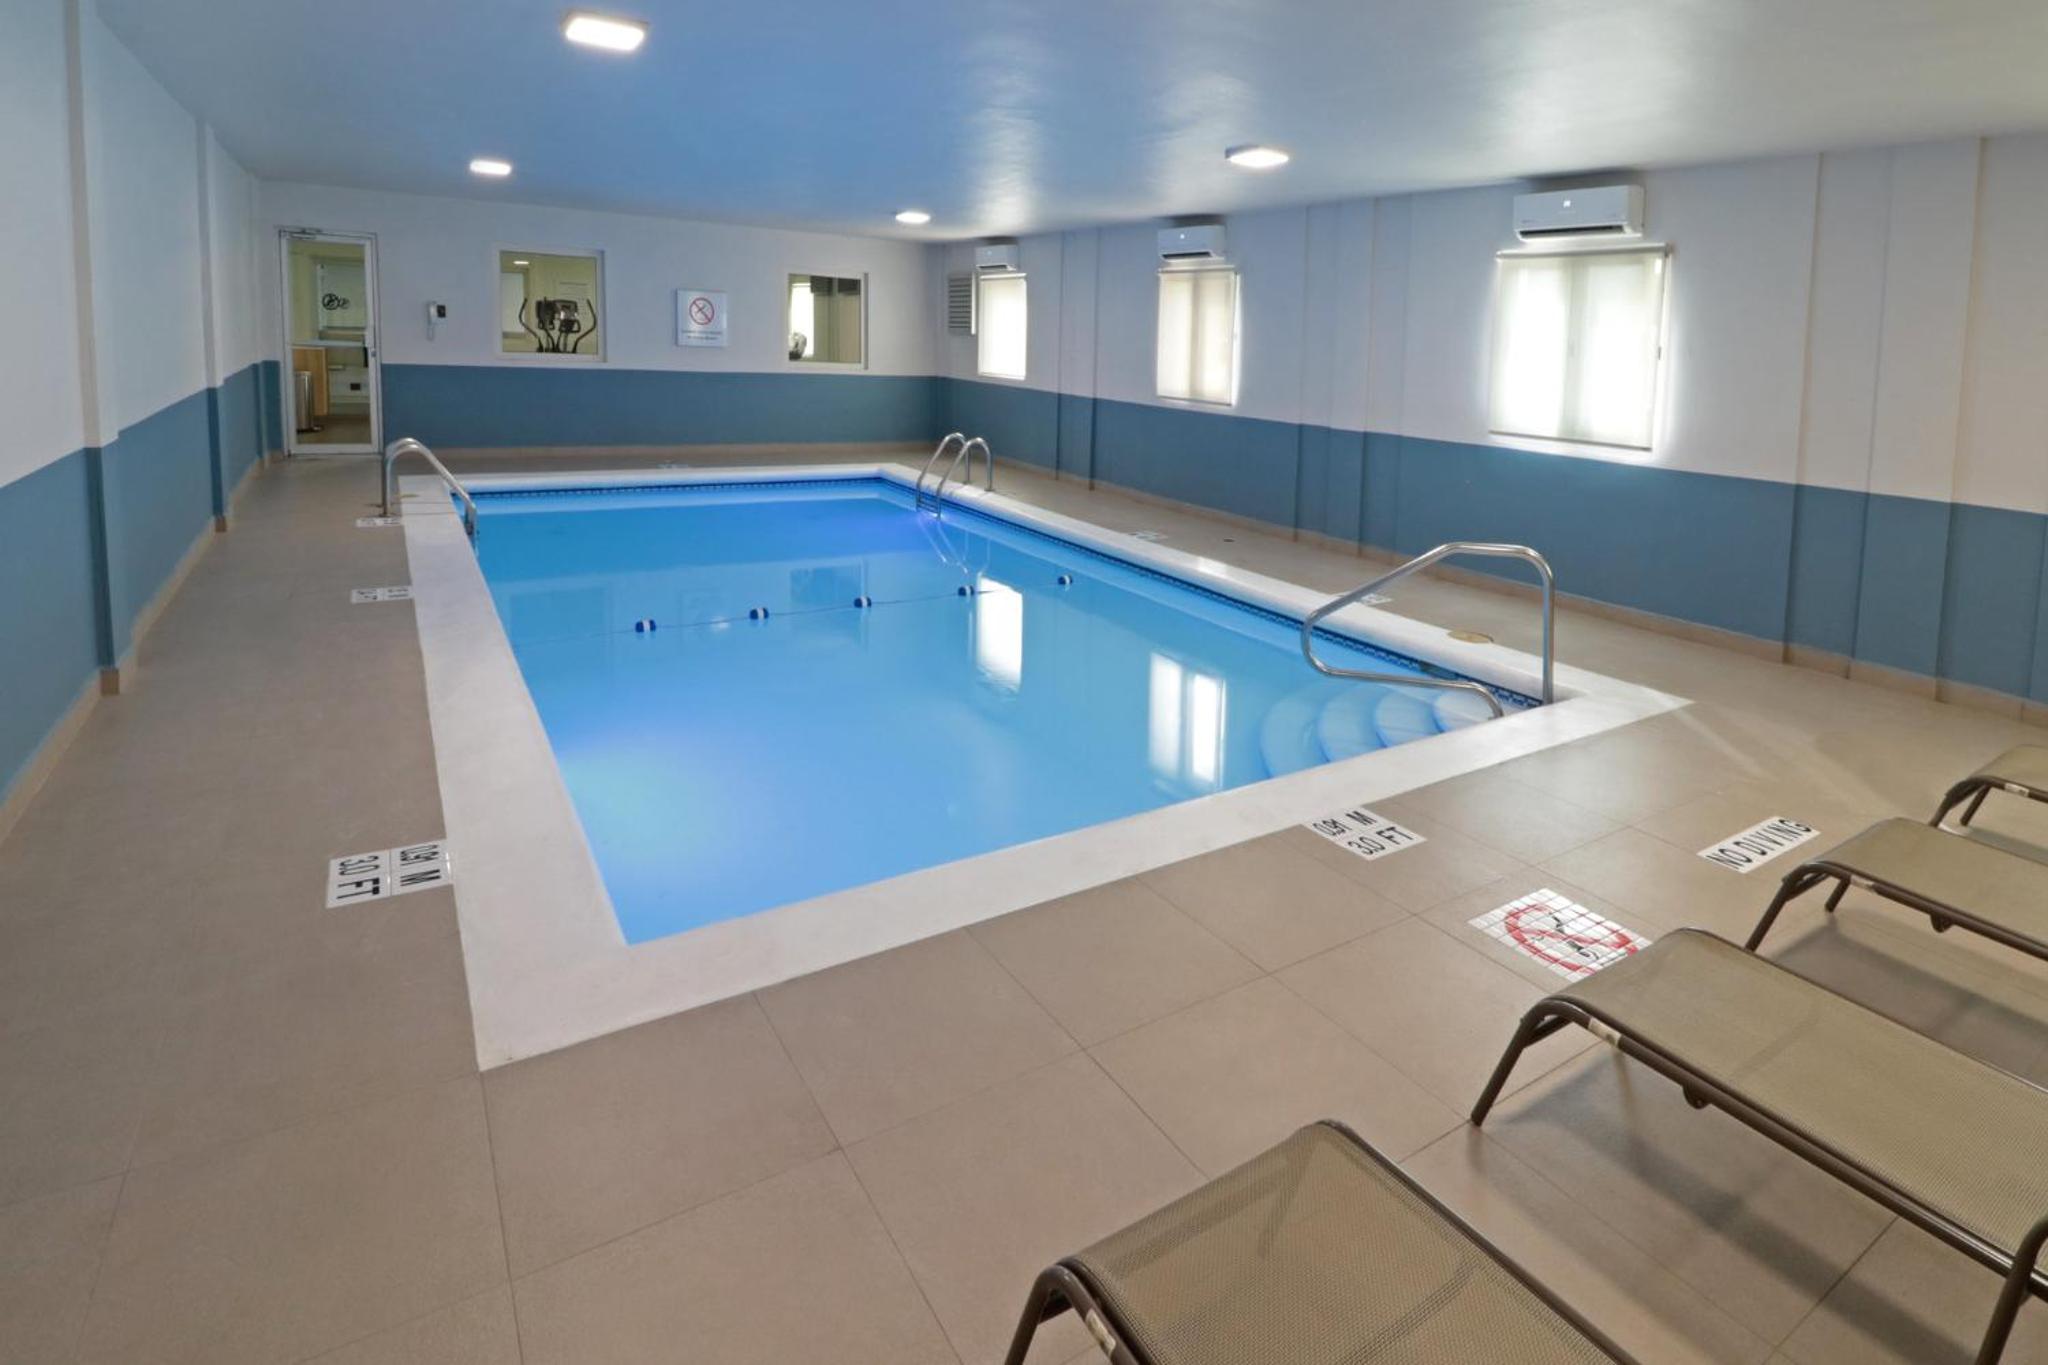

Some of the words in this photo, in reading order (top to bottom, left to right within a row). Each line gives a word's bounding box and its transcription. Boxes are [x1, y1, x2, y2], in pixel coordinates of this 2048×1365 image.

[1345, 810, 1377, 826] M
[1376, 826, 1414, 845] FT
[1706, 848, 1753, 870] NO
[1733, 818, 1812, 856] DIVING
[400, 868, 441, 887] M
[336, 877, 380, 900] FT
